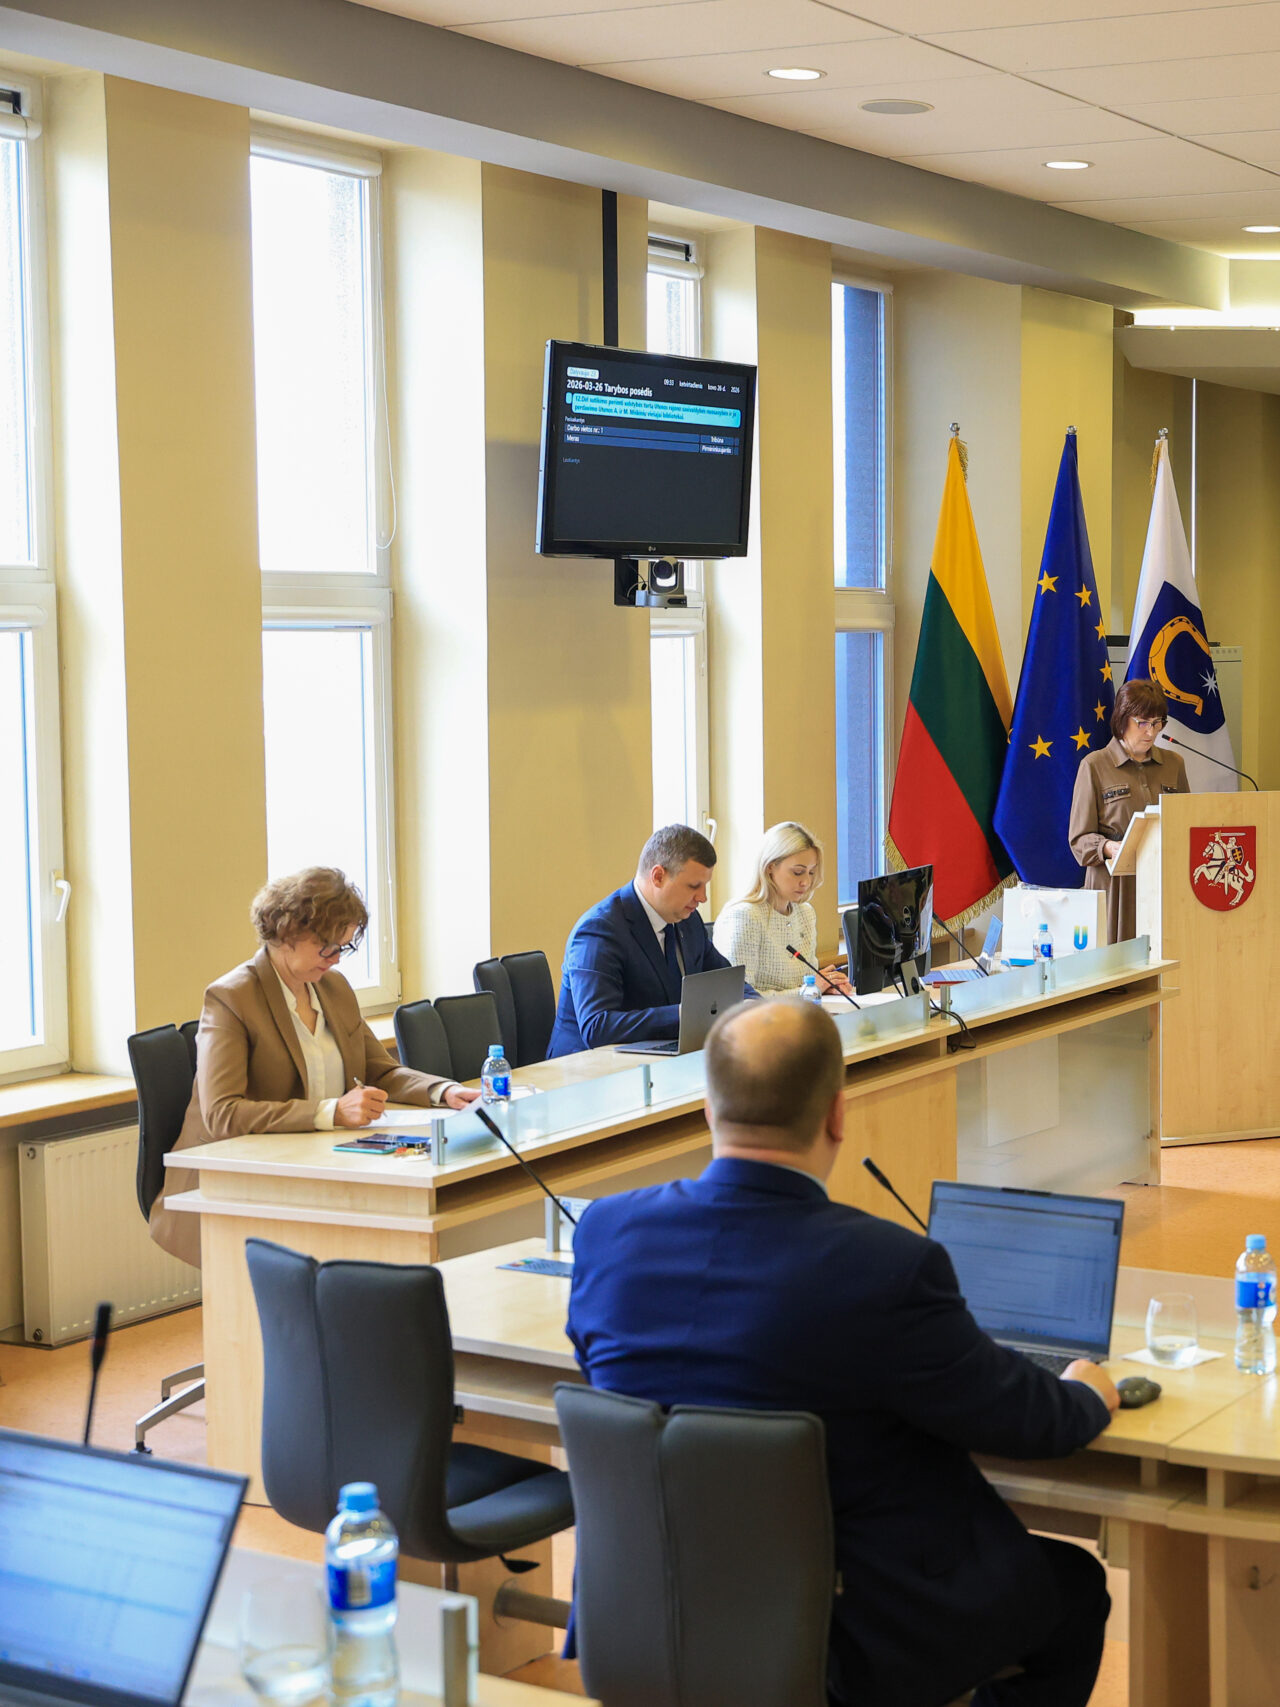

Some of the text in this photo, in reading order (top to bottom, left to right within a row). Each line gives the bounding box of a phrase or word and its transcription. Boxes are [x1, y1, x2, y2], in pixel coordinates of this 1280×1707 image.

[567, 379, 653, 397] 2026-03-26 Tarybos posėdis
[1074, 925, 1088, 951] U
